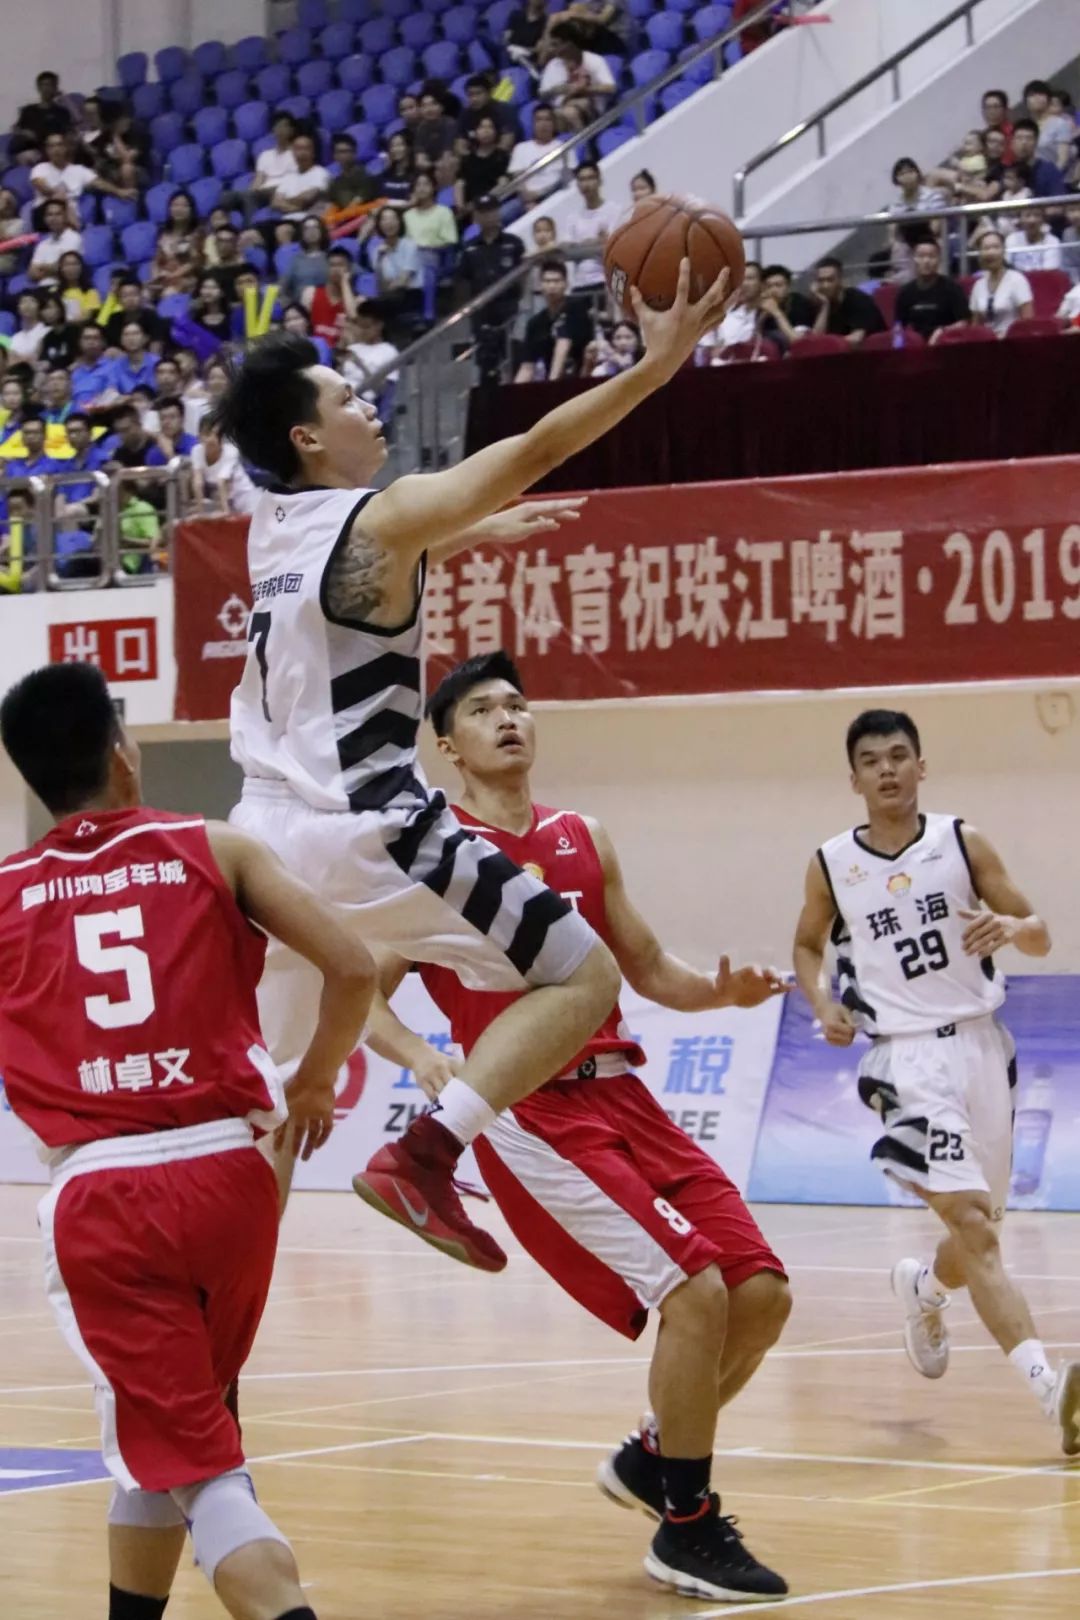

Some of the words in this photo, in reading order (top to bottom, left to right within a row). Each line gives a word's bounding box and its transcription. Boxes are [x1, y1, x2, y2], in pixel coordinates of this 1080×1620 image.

[62, 625, 150, 675] 出口
[249, 611, 272, 723] 7
[74, 904, 156, 1030] 5
[894, 929, 949, 981] 29
[77, 1047, 194, 1094] 林卓文
[653, 1196, 691, 1235] 8
